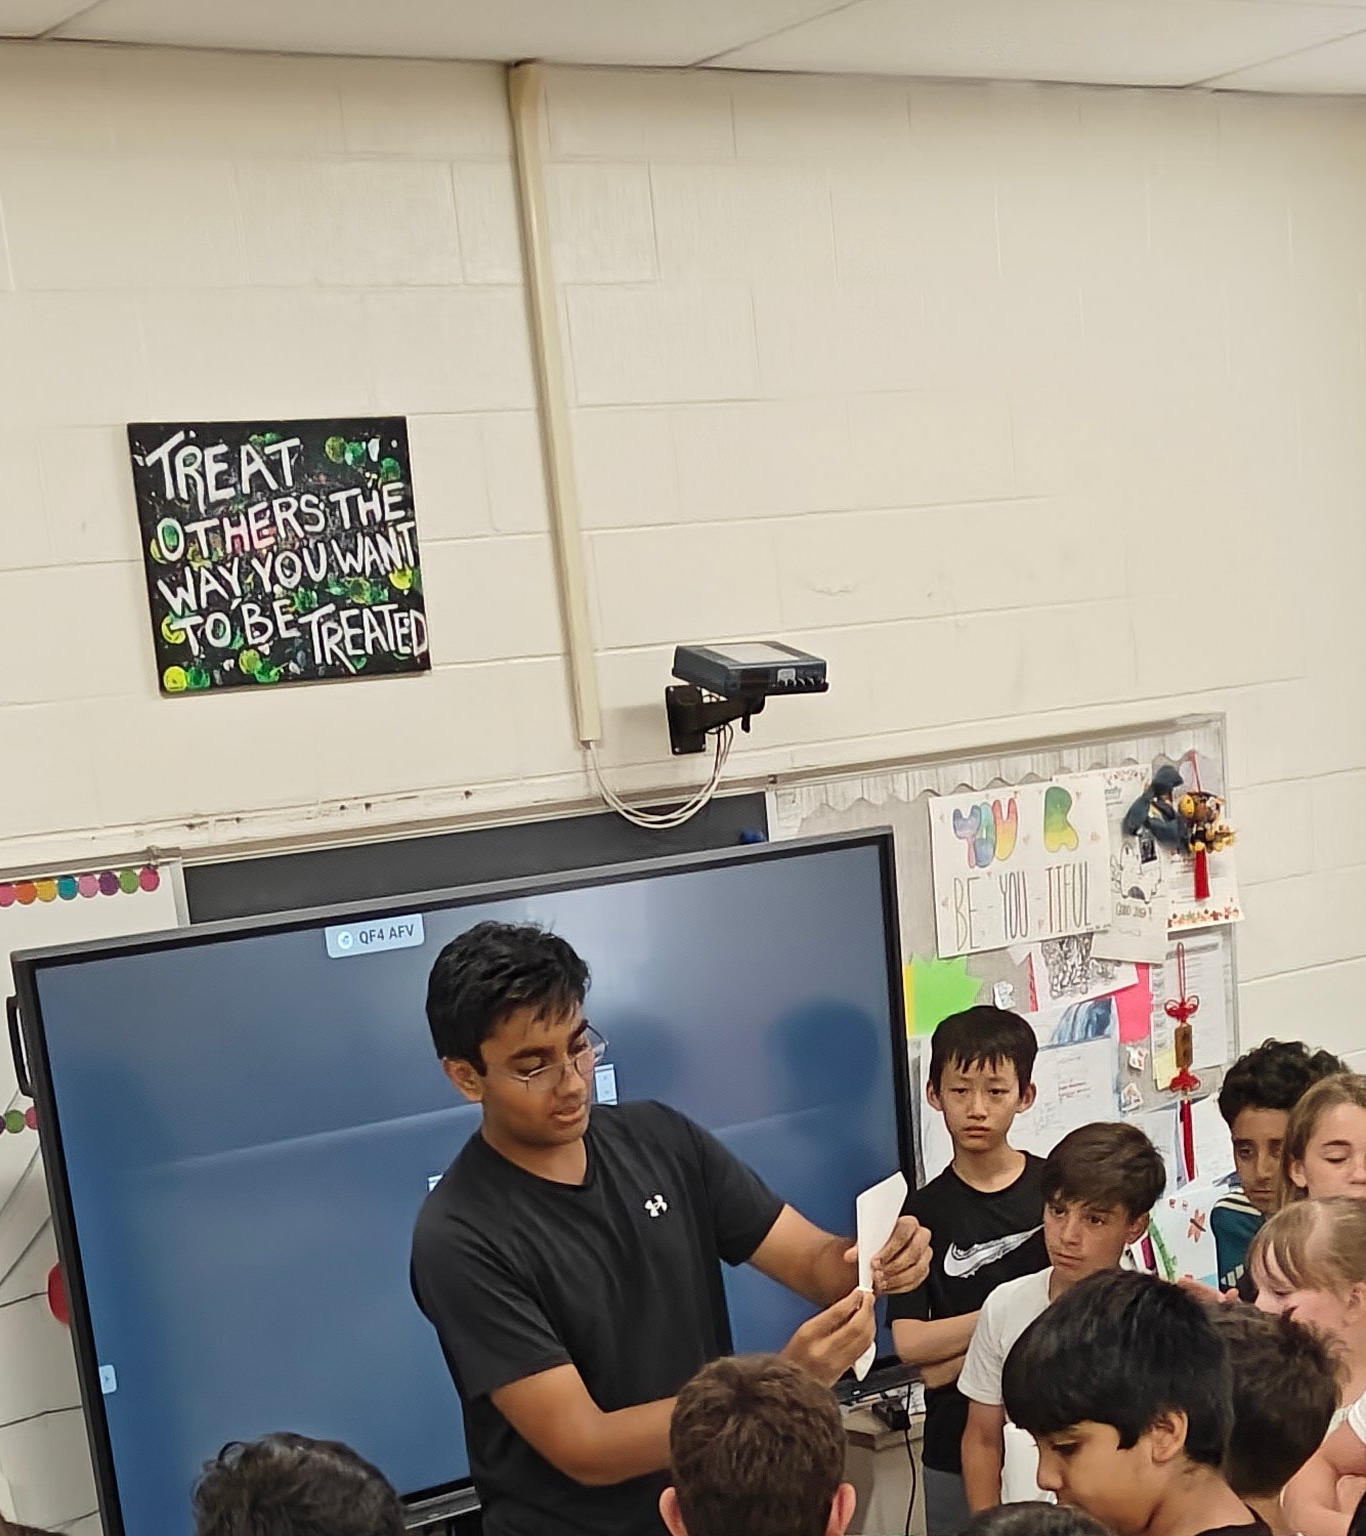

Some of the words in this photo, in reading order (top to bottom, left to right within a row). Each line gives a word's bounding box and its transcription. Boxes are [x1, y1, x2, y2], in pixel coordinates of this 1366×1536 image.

[146, 431, 301, 513] TREAT
[156, 494, 326, 562] OTHERS
[328, 482, 405, 530] THE
[157, 557, 243, 617] WAY
[251, 541, 328, 590] YOU
[331, 521, 416, 577] WANT
[169, 611, 232, 657] TO
[241, 599, 301, 646] BE
[297, 603, 429, 674] TREATED
[952, 797, 1018, 868] YOU
[1043, 786, 1079, 852] R
[359, 929, 385, 945] QF4
[389, 924, 414, 940] AFV
[953, 875, 981, 951] BE
